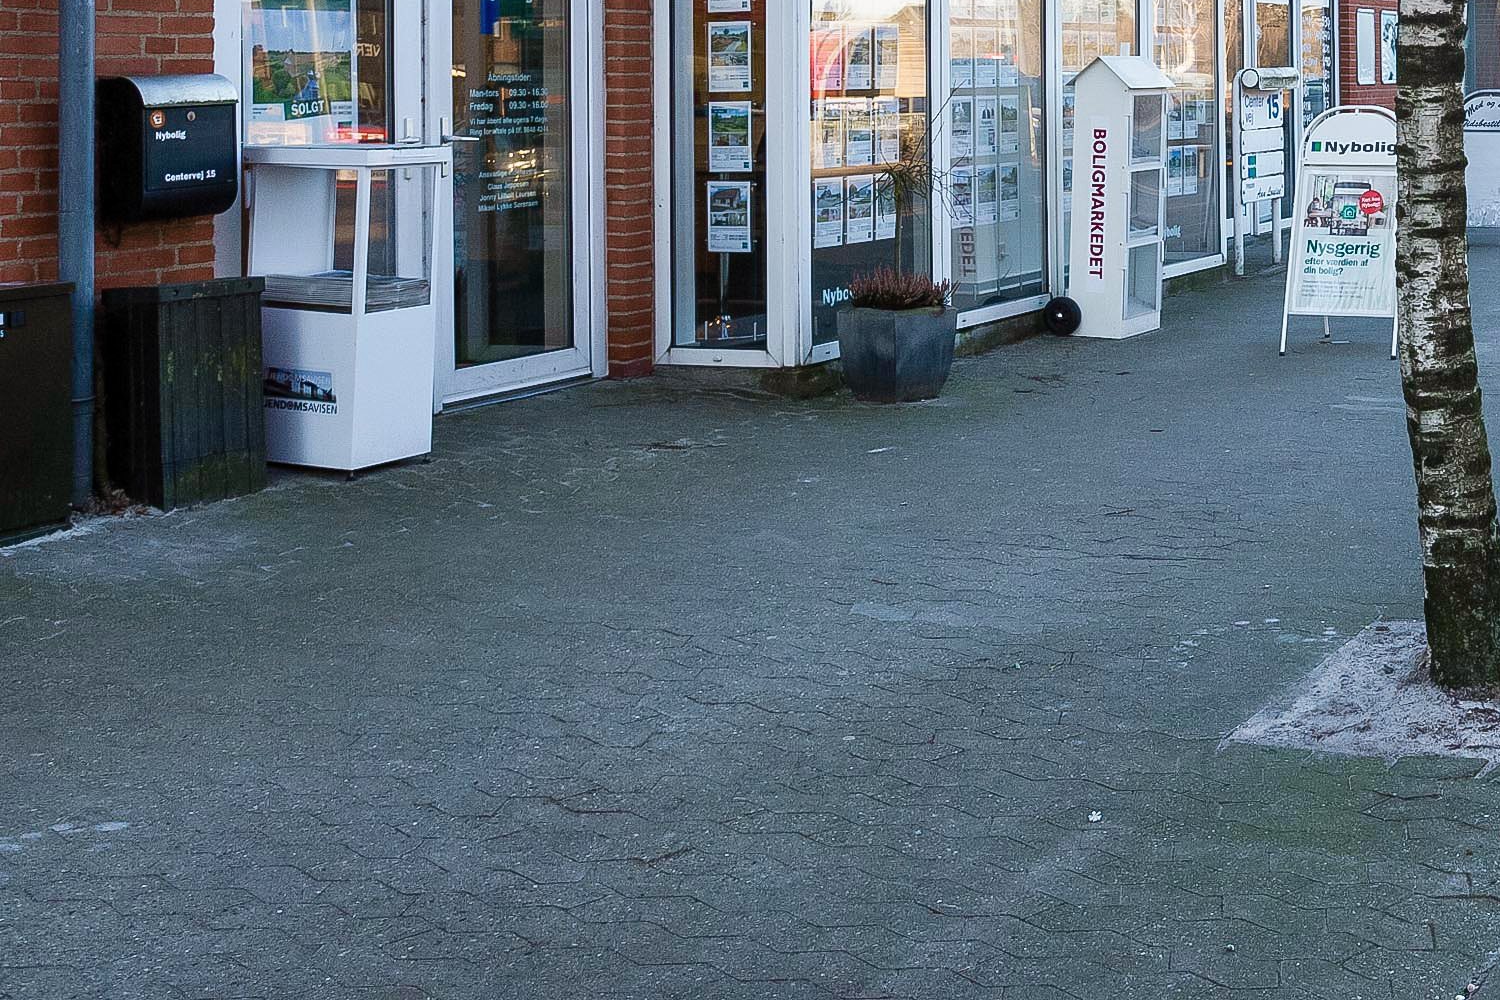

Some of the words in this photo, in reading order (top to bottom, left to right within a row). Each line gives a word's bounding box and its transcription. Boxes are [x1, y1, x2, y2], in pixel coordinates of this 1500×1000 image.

[509, 88, 527, 97] 09.30
[532, 88, 549, 96] 16.30
[291, 100, 325, 116] SOLGT
[469, 102, 494, 112] Fredag
[509, 101, 527, 110] 09.30
[532, 100, 549, 109] 16.00
[1244, 94, 1265, 108] Center
[1266, 93, 1280, 120] 15
[1465, 100, 1484, 118] Med
[1487, 101, 1496, 109] og
[1245, 109, 1254, 126] vej
[155, 130, 186, 141] Nybolig
[1325, 141, 1397, 156] Nybolig
[164, 171, 205, 182] Centervej
[206, 169, 217, 179] 15
[1089, 128, 1107, 280] BOLIGMARKEDET
[1306, 239, 1381, 258] Nysgerrig
[1304, 257, 1324, 265] efter
[1326, 258, 1358, 267] værdien
[1360, 259, 1369, 267] af
[1304, 266, 1316, 274] din
[1318, 267, 1344, 277] bolig?
